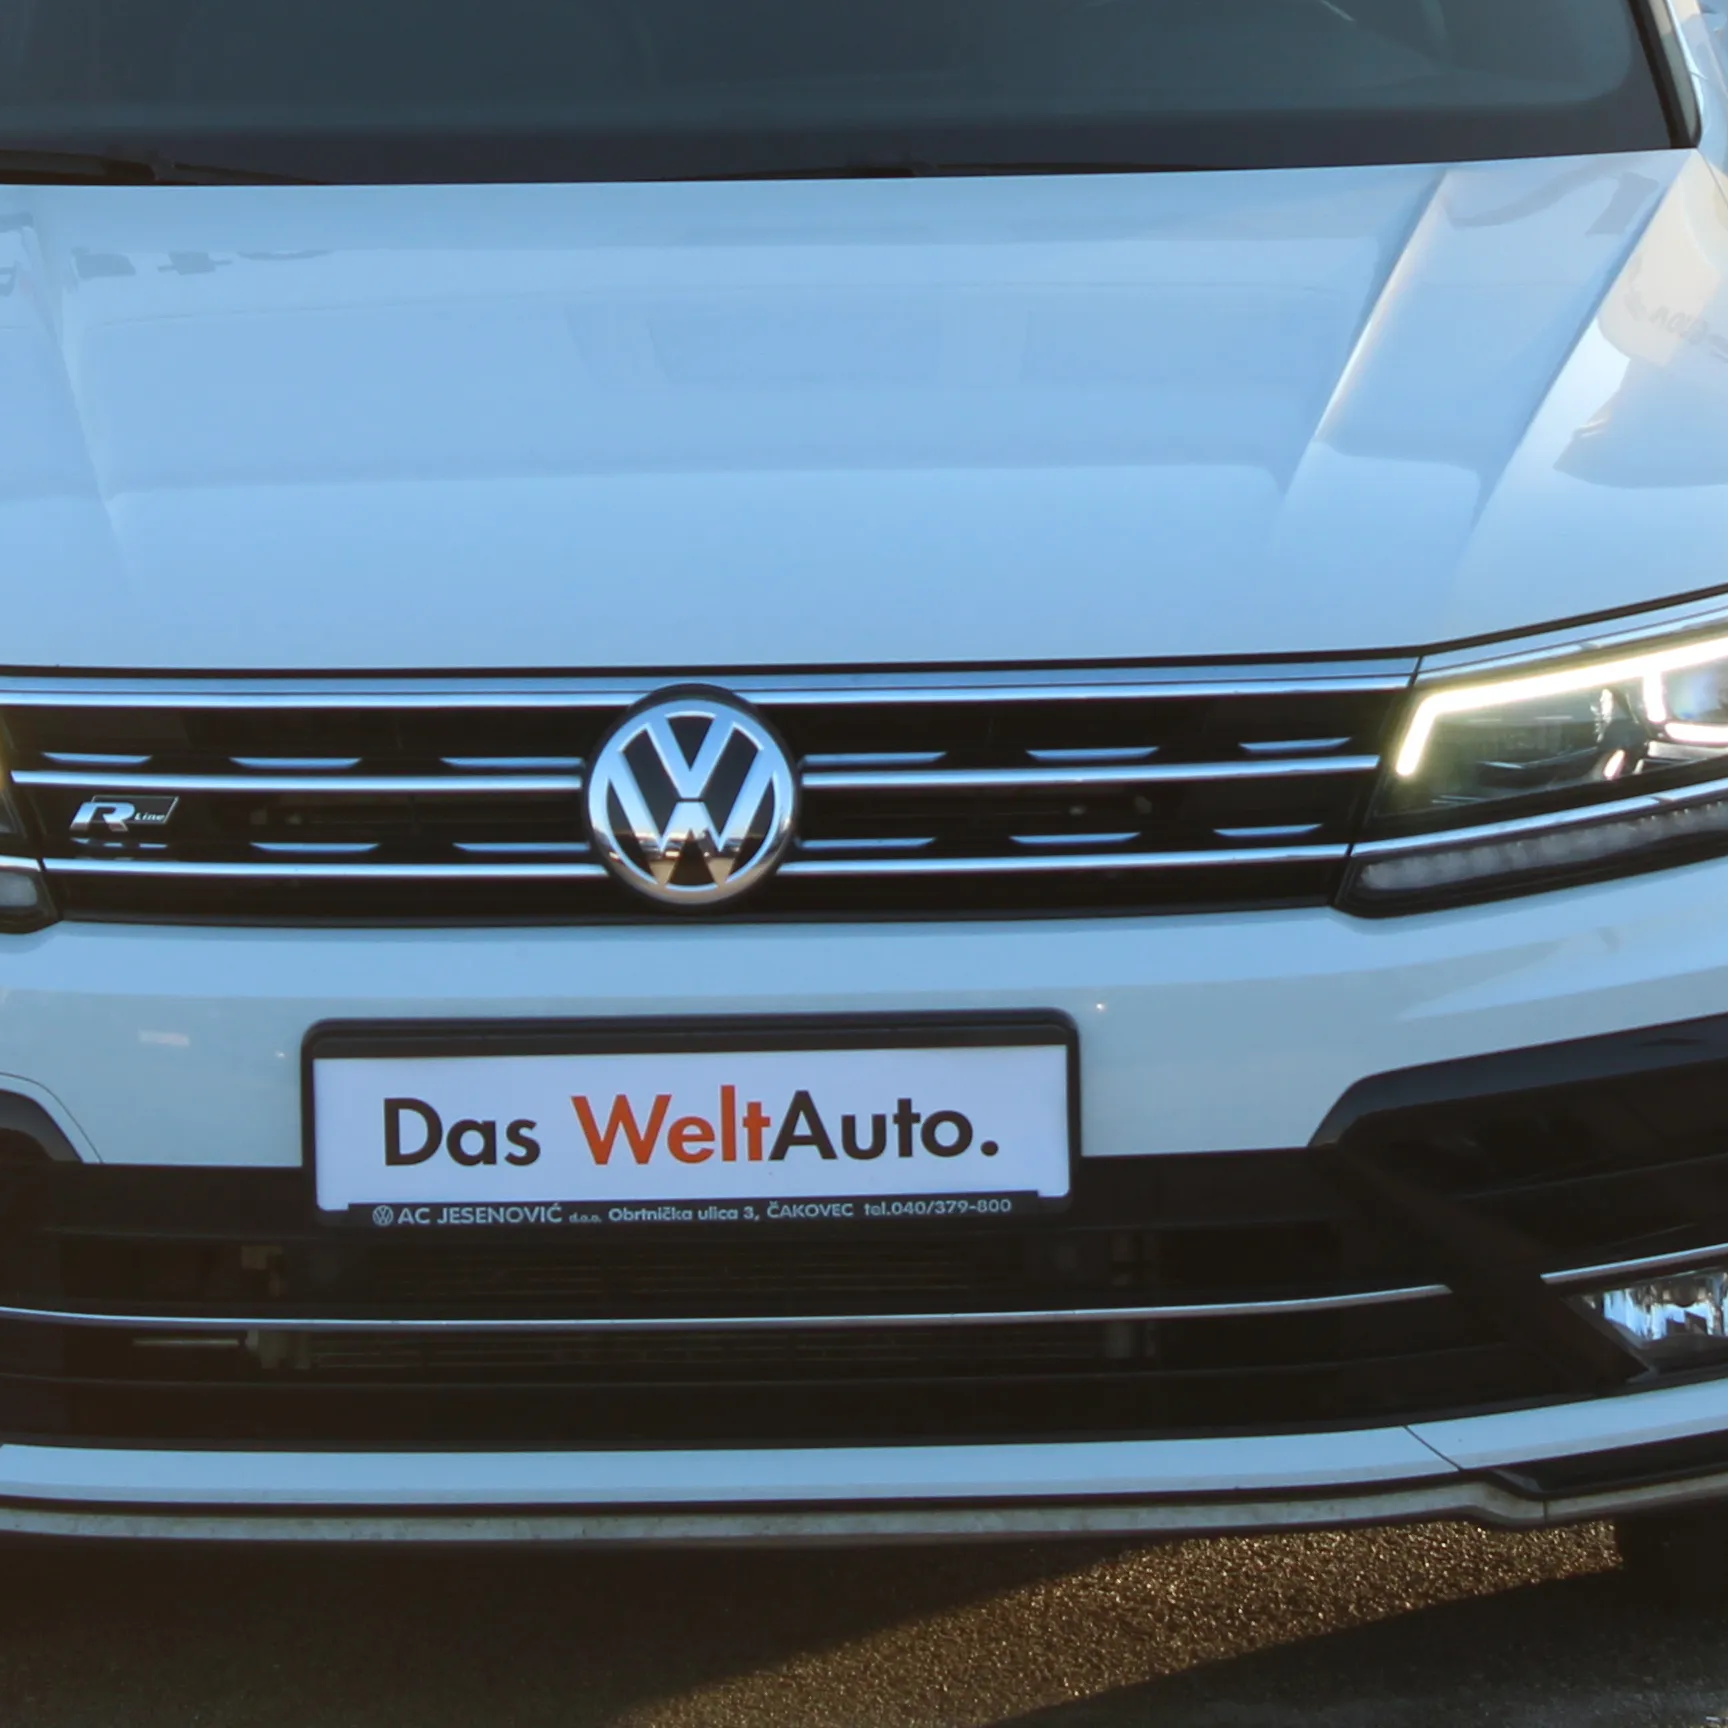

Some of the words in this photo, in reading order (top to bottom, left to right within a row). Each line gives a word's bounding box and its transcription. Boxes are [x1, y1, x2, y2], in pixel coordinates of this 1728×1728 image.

[382, 1097, 541, 1167] Das
[571, 1085, 999, 1166] WeltAuto.
[397, 1207, 431, 1225] AC
[569, 1212, 603, 1223] d.o.o.
[608, 1206, 693, 1222] Obrtnička
[697, 1205, 739, 1221] ulica
[743, 1205, 760, 1222] 3,
[766, 1200, 855, 1219] ČAKOVEC
